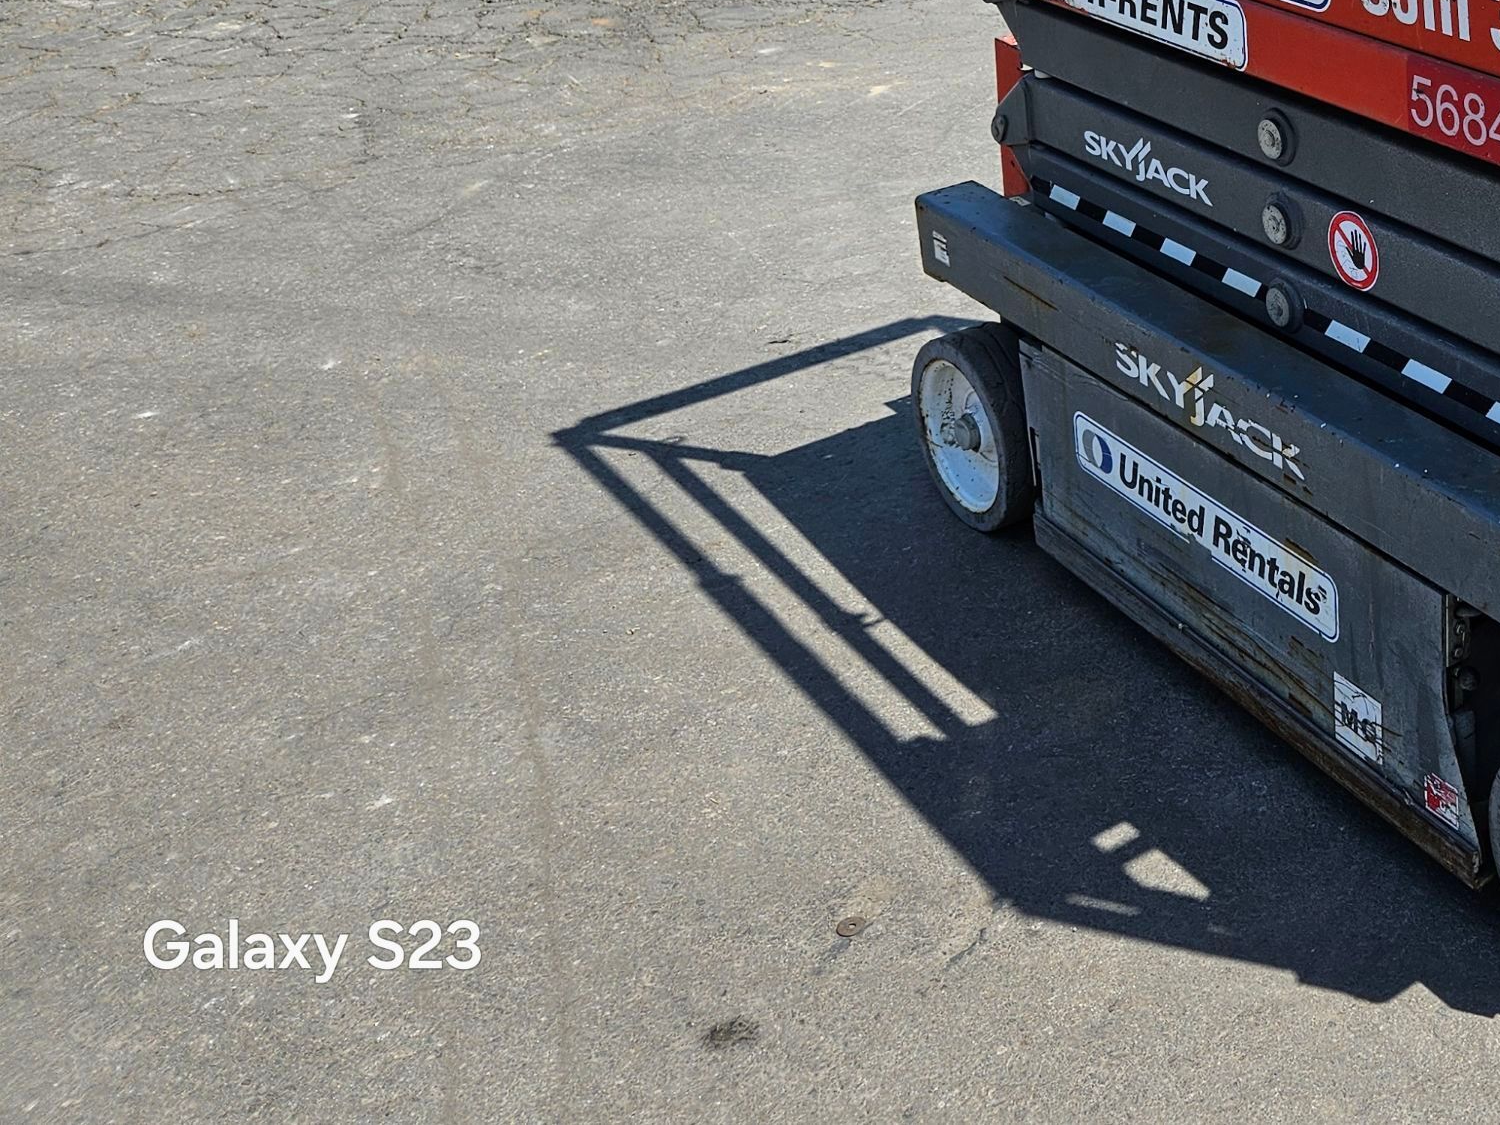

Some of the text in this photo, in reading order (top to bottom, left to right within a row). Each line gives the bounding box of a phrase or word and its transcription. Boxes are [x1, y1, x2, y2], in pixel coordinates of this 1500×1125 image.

[1083, 129, 1213, 207] SKYJACK
[1115, 342, 1305, 481] SKYJACK
[1119, 453, 1322, 616] United Rentals
